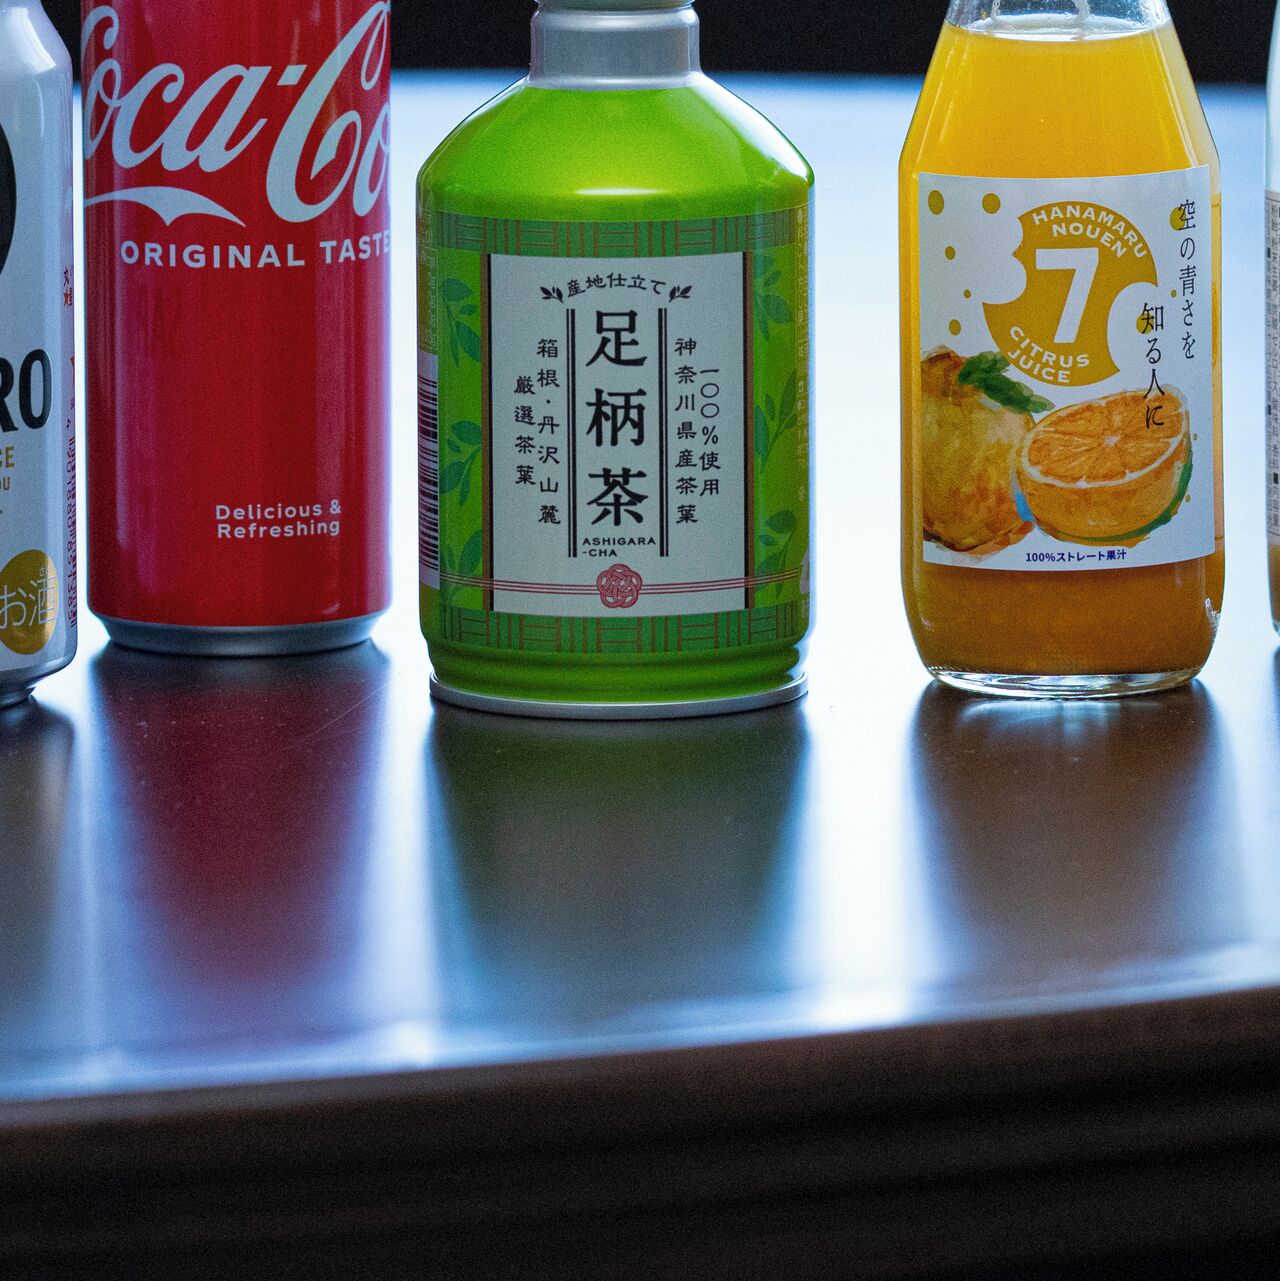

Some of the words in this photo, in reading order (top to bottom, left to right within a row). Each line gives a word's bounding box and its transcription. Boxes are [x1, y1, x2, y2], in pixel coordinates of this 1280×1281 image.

[1032, 204, 1148, 259] HANAMARU
[1051, 221, 1128, 258] NOUEN
[121, 239, 305, 268] ORIGINAL
[566, 271, 667, 298] 産地仕立て
[1035, 247, 1099, 344] 7
[1178, 198, 1197, 360] 空の青さを
[1007, 347, 1071, 383] JUICE
[1009, 325, 1091, 368] CITRUS
[1140, 302, 1165, 429] 知る人に
[514, 376, 536, 487] 厳選茶葉
[537, 338, 561, 525] 箱根・丹沢山麓
[585, 309, 648, 527] 足柄茶
[674, 338, 698, 524] 神奈川県産茶葉
[215, 503, 322, 520] Delicious
[329, 498, 341, 515] &
[217, 519, 341, 539] Refreshing
[582, 535, 657, 547] ASHIGARA
[582, 549, 618, 558] -CHA
[1025, 548, 1127, 563] 100%ストレート果汁
